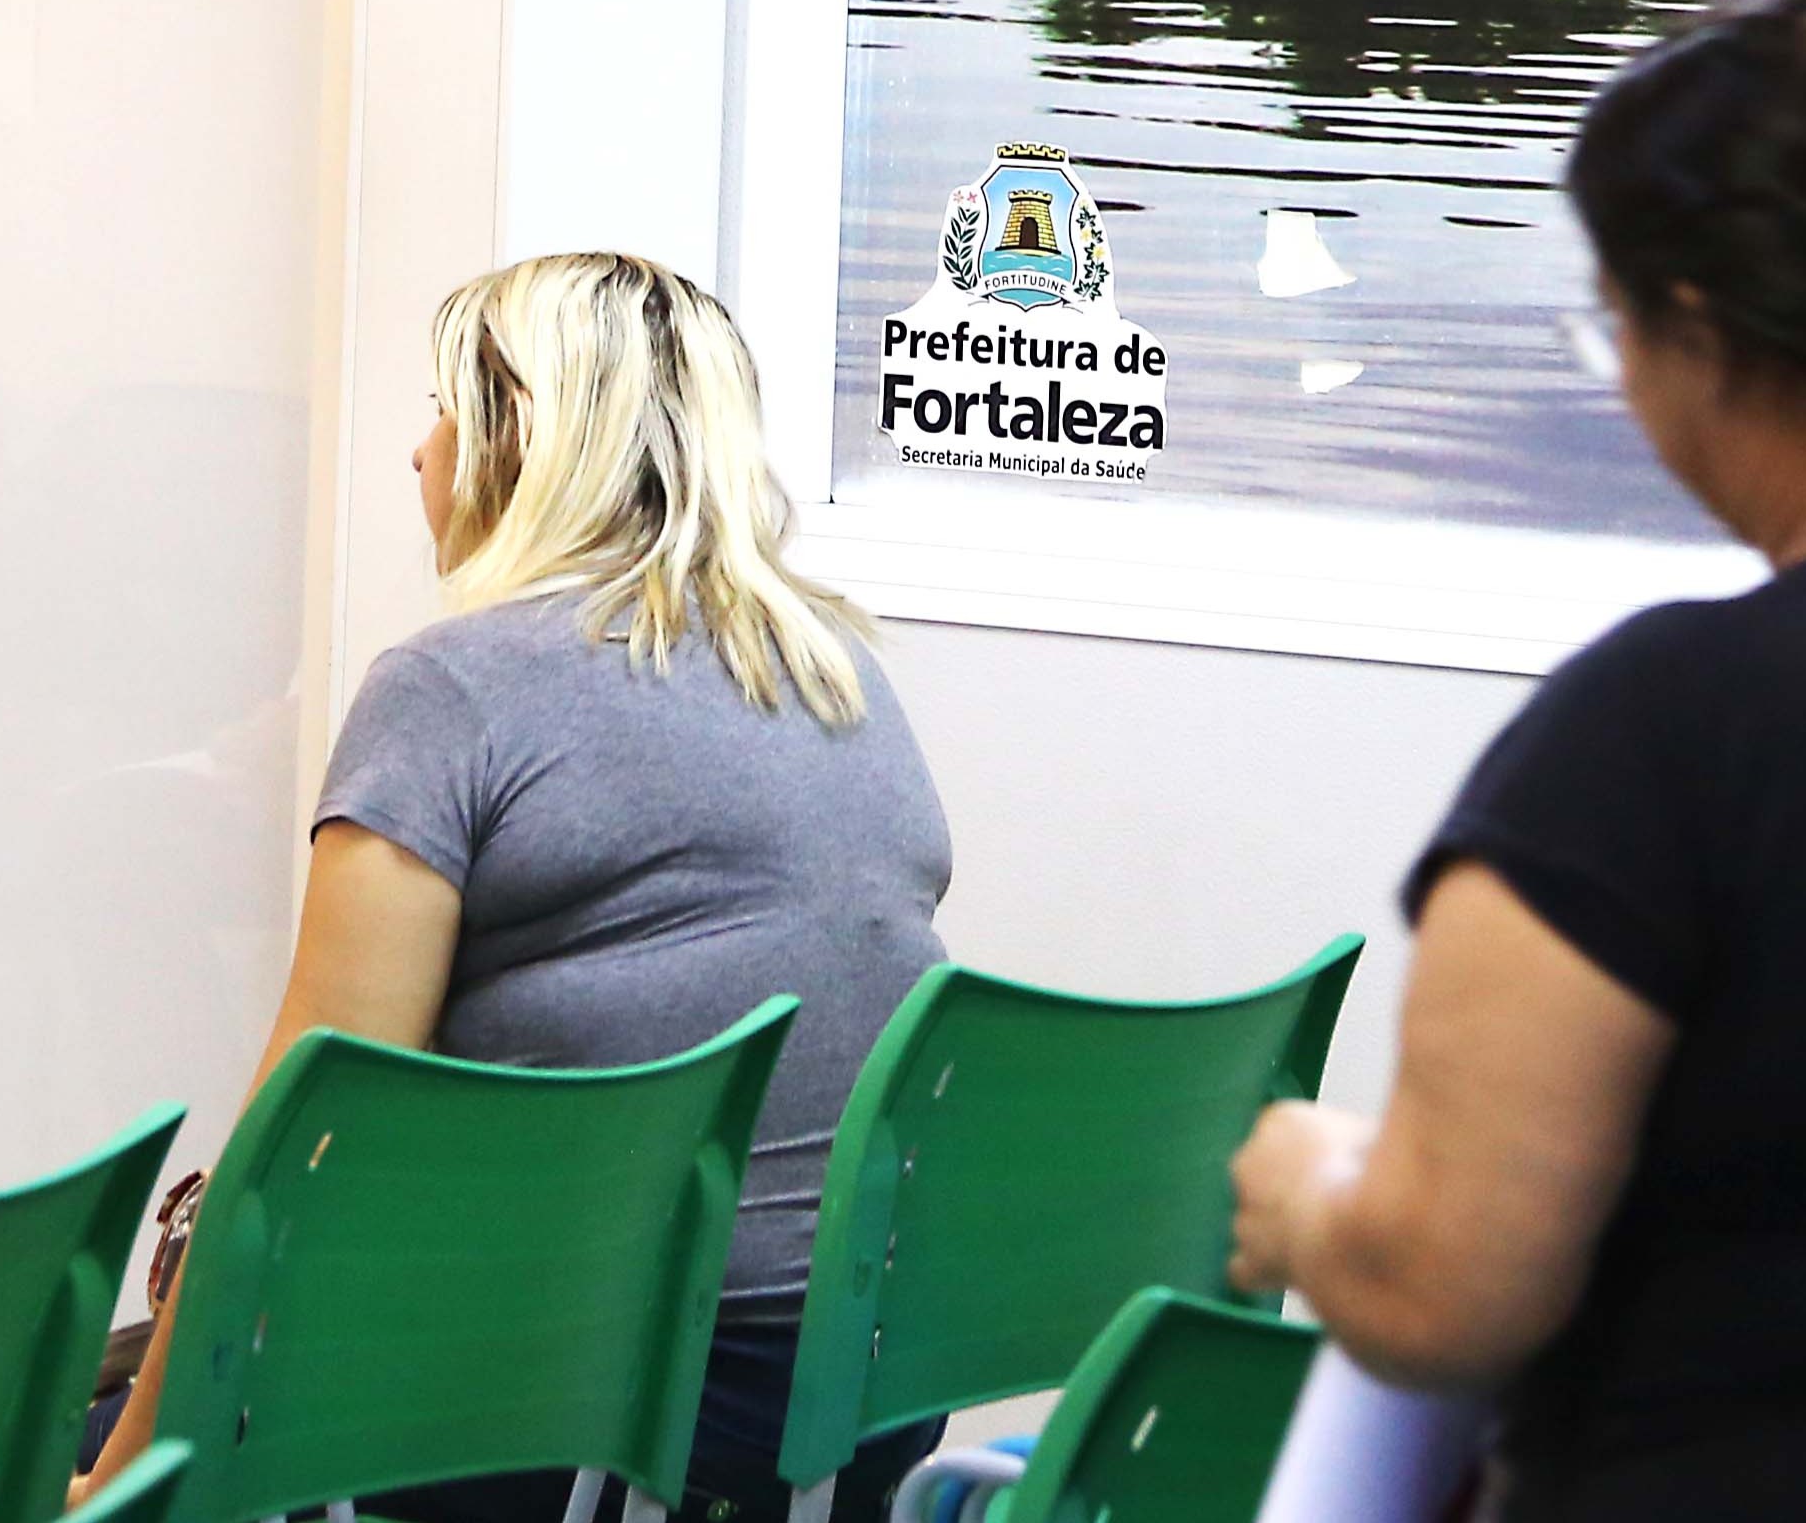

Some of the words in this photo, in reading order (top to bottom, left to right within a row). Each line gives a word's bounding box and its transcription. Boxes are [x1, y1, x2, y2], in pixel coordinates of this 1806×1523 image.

[984, 274, 1068, 296] FORTITUDINE
[884, 319, 1098, 372] Prefeitura
[1114, 333, 1166, 376] de
[881, 373, 1164, 450] Fortaleza
[901, 445, 983, 468] Secretaria
[989, 452, 1065, 476] Municipal
[1070, 459, 1090, 476] da
[1095, 458, 1145, 480] Saúde
